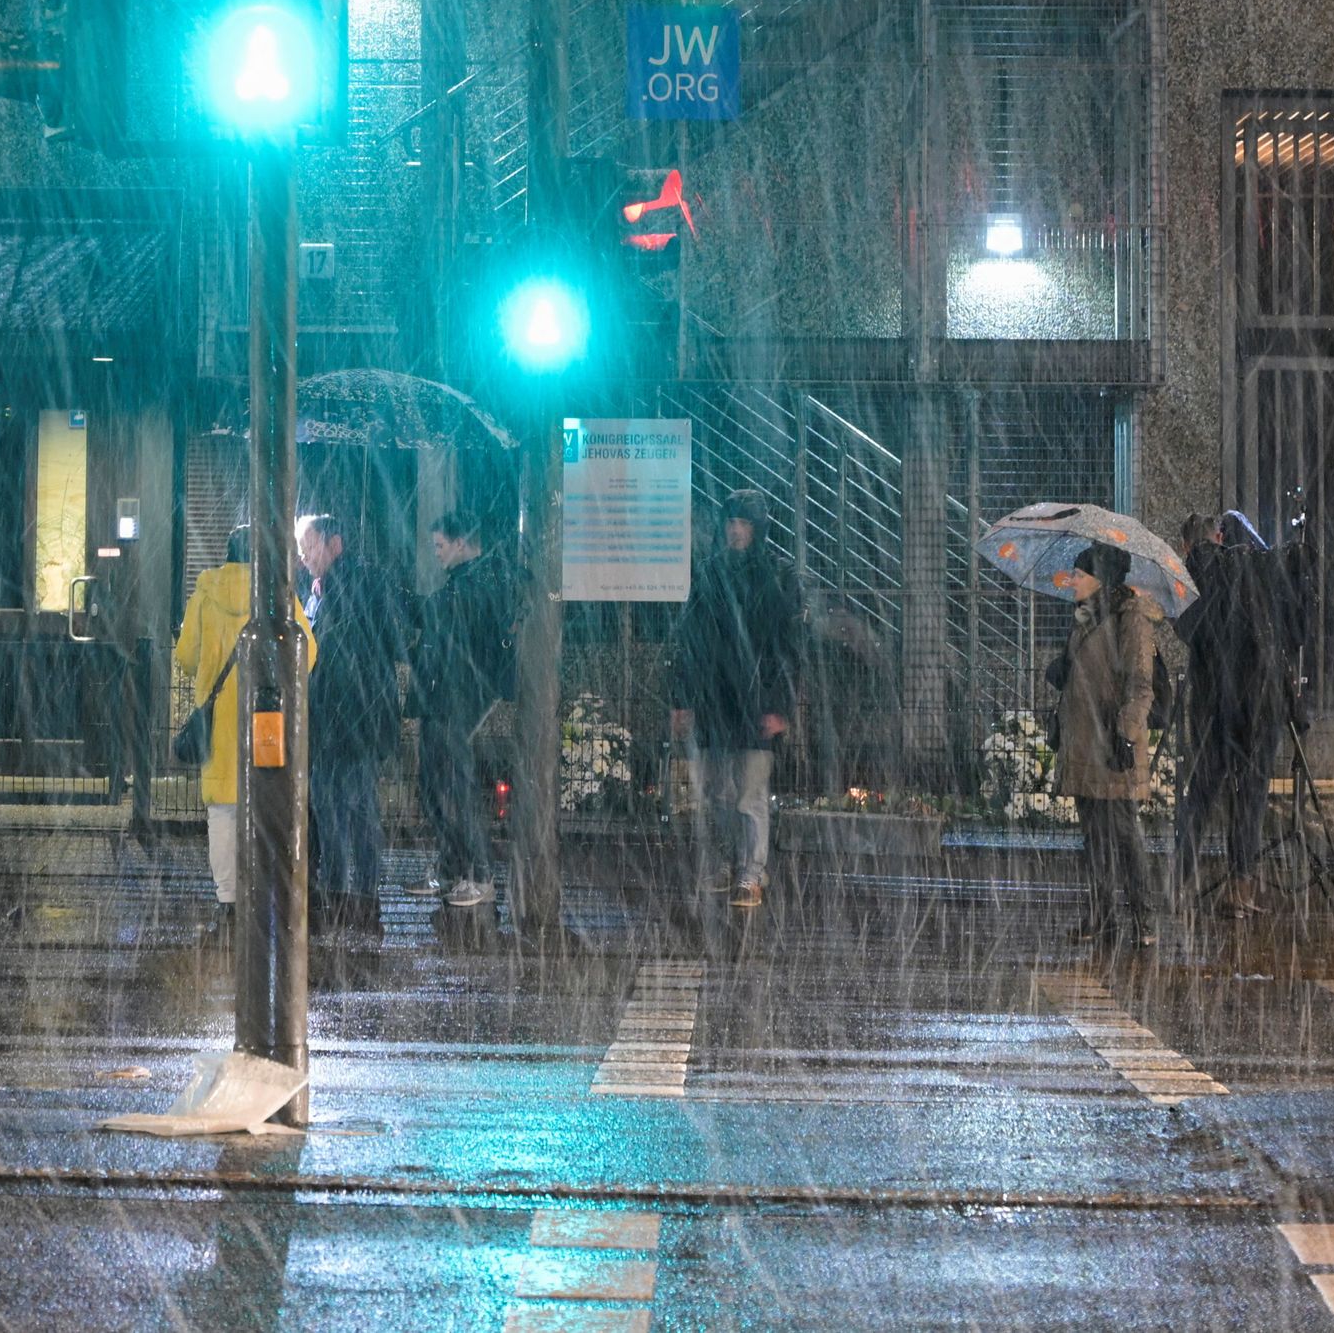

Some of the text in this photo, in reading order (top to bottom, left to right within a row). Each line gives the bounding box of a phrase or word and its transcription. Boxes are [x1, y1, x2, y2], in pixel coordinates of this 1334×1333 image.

[648, 24, 719, 66] JW
[642, 72, 719, 102] .ORG
[307, 250, 327, 274] 17
[582, 447, 631, 459] JEHOVAS
[634, 447, 677, 459] ZEUGEN
